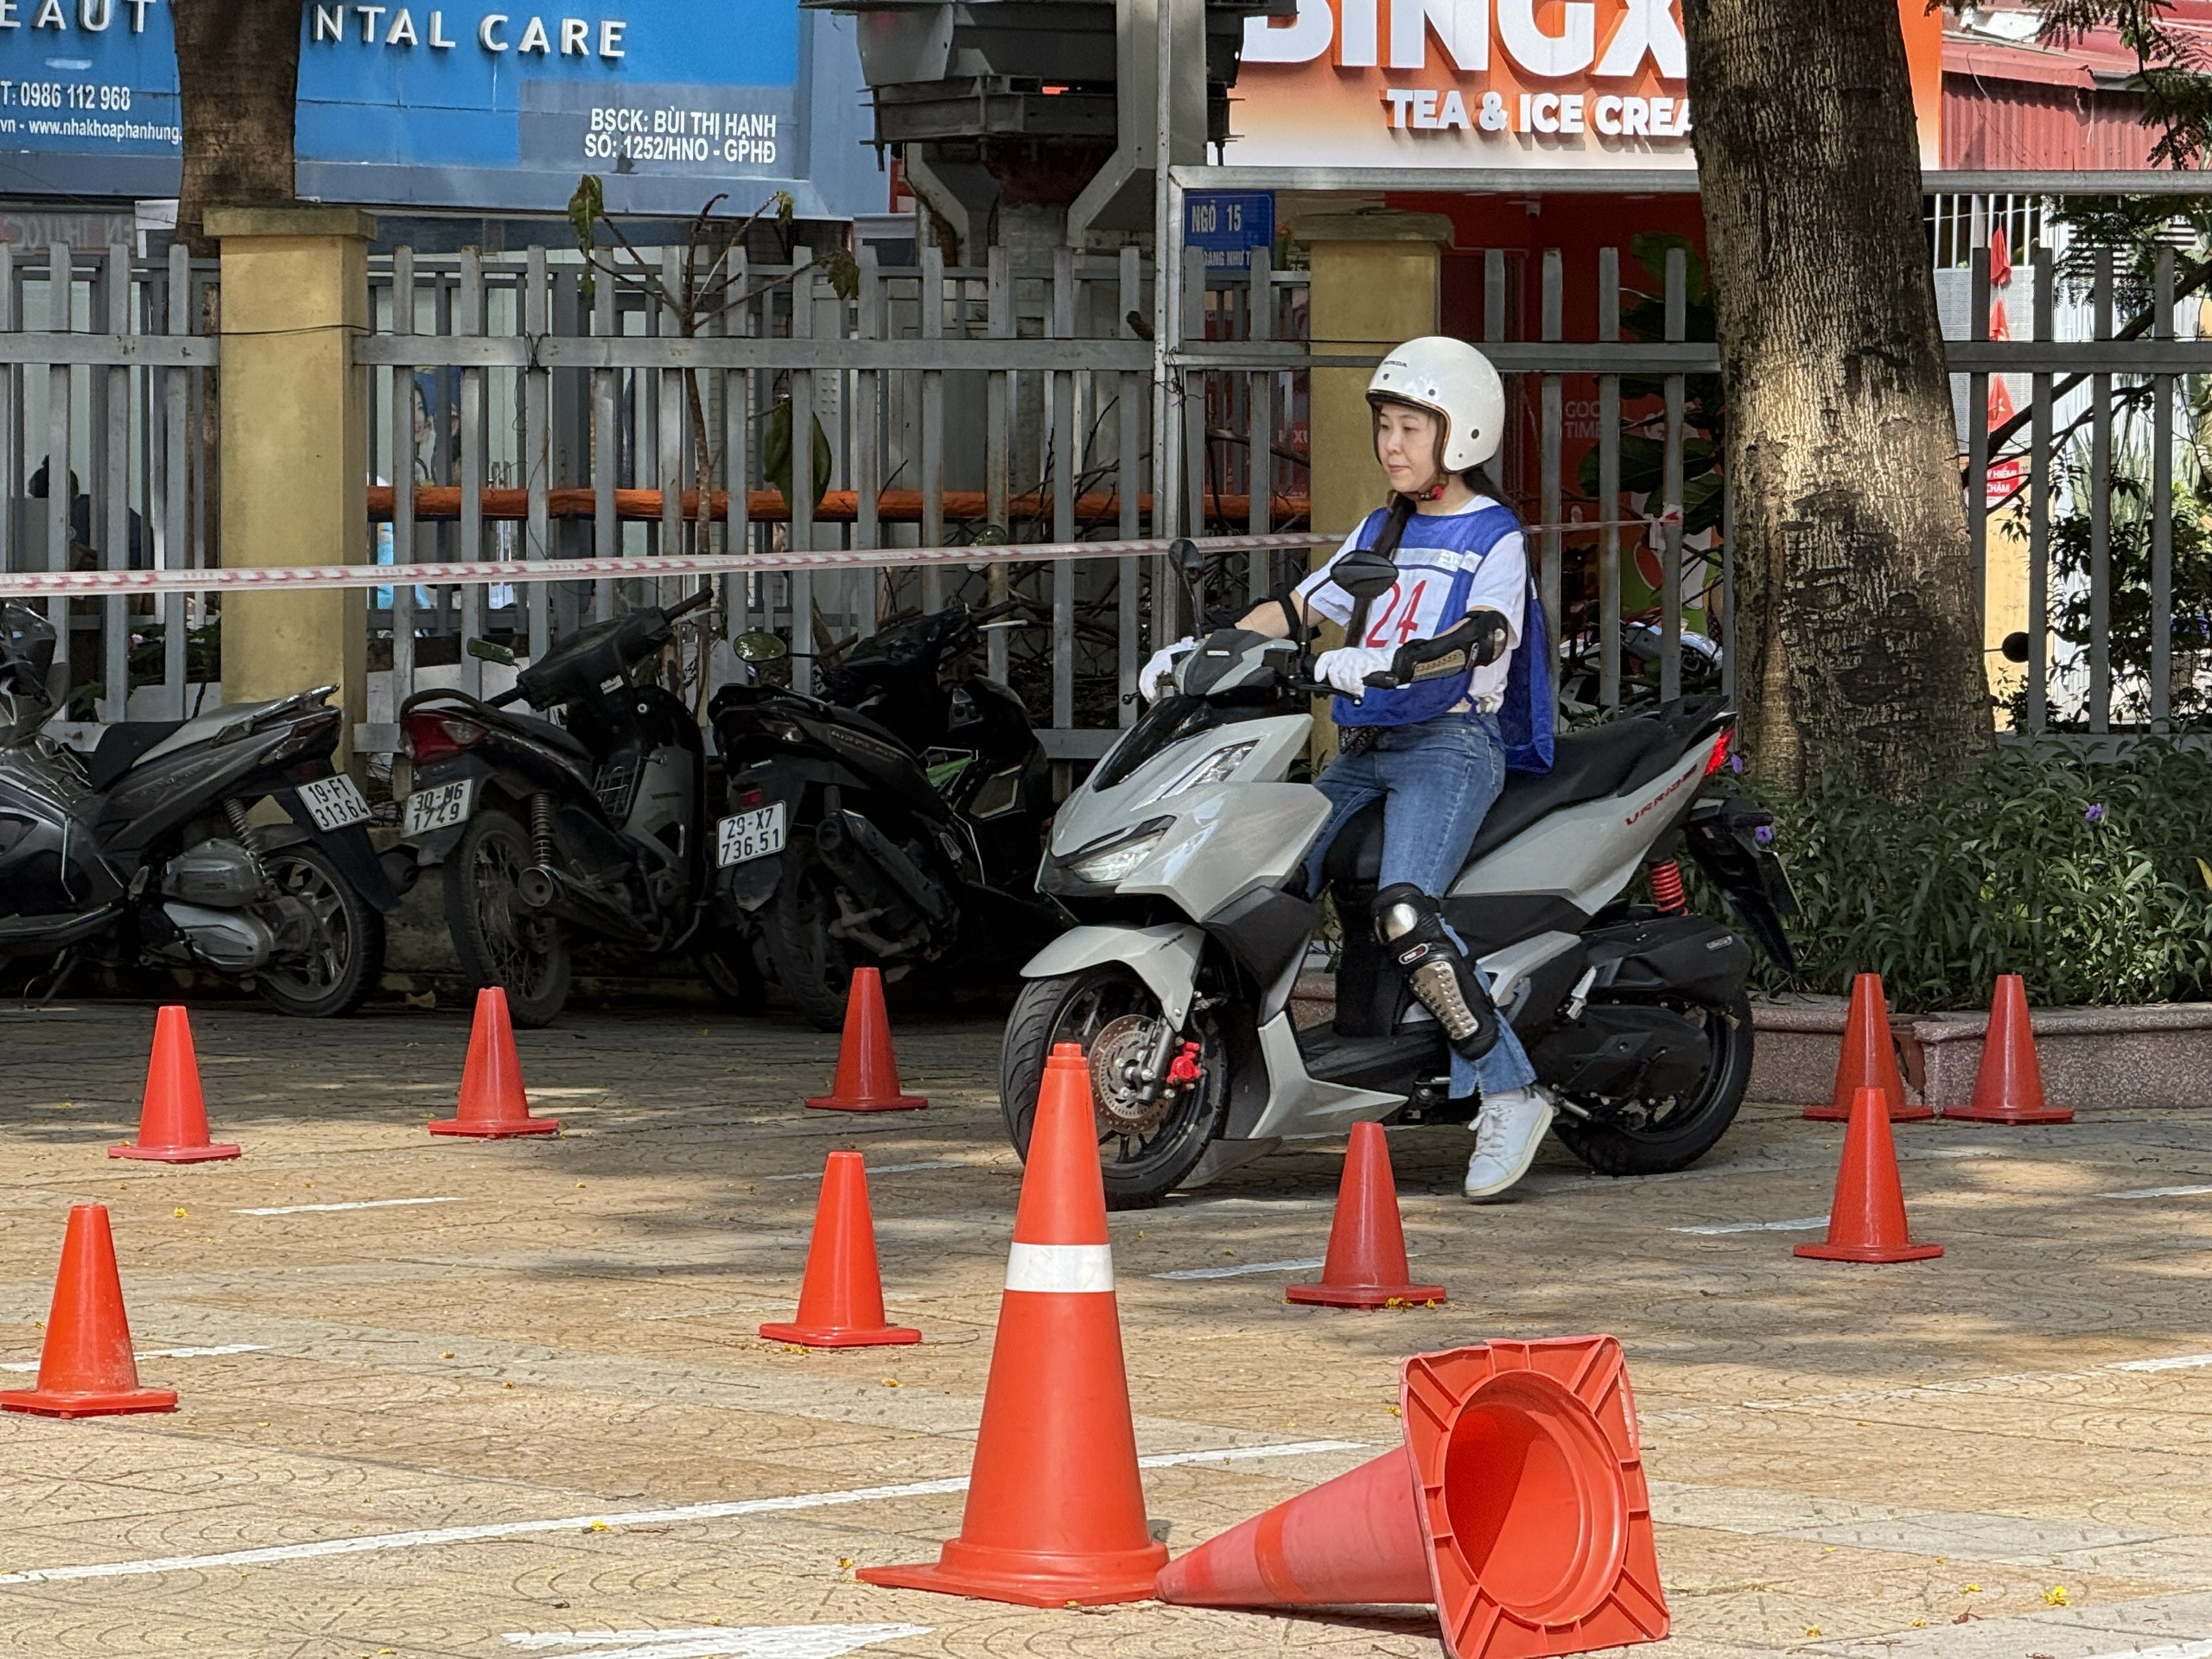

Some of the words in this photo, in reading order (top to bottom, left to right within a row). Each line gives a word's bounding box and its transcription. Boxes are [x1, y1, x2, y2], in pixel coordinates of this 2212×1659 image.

[479, 14, 626, 59] CARE
[20, 82, 61, 108] 0986
[67, 84, 95, 109] 112
[100, 86, 130, 111] 968
[1386, 89, 1469, 130] TEA
[1478, 93, 1508, 131] &
[1518, 93, 1584, 134] ICE
[591, 108, 648, 132] BSCK:
[654, 105, 684, 134] BÙI
[690, 111, 720, 140] THỊ
[724, 113, 776, 140] HẠNH
[584, 131, 617, 158] SỐ:
[623, 136, 709, 162] 1252/HNO
[724, 139, 776, 164] GPHĐ
[1192, 200, 1217, 232] NGÕ
[1227, 204, 1242, 232] 15
[1366, 580, 1427, 648] 24
[308, 777, 351, 804] 19-F1
[728, 807, 773, 840] 29-X7
[721, 828, 779, 865] 736.51
